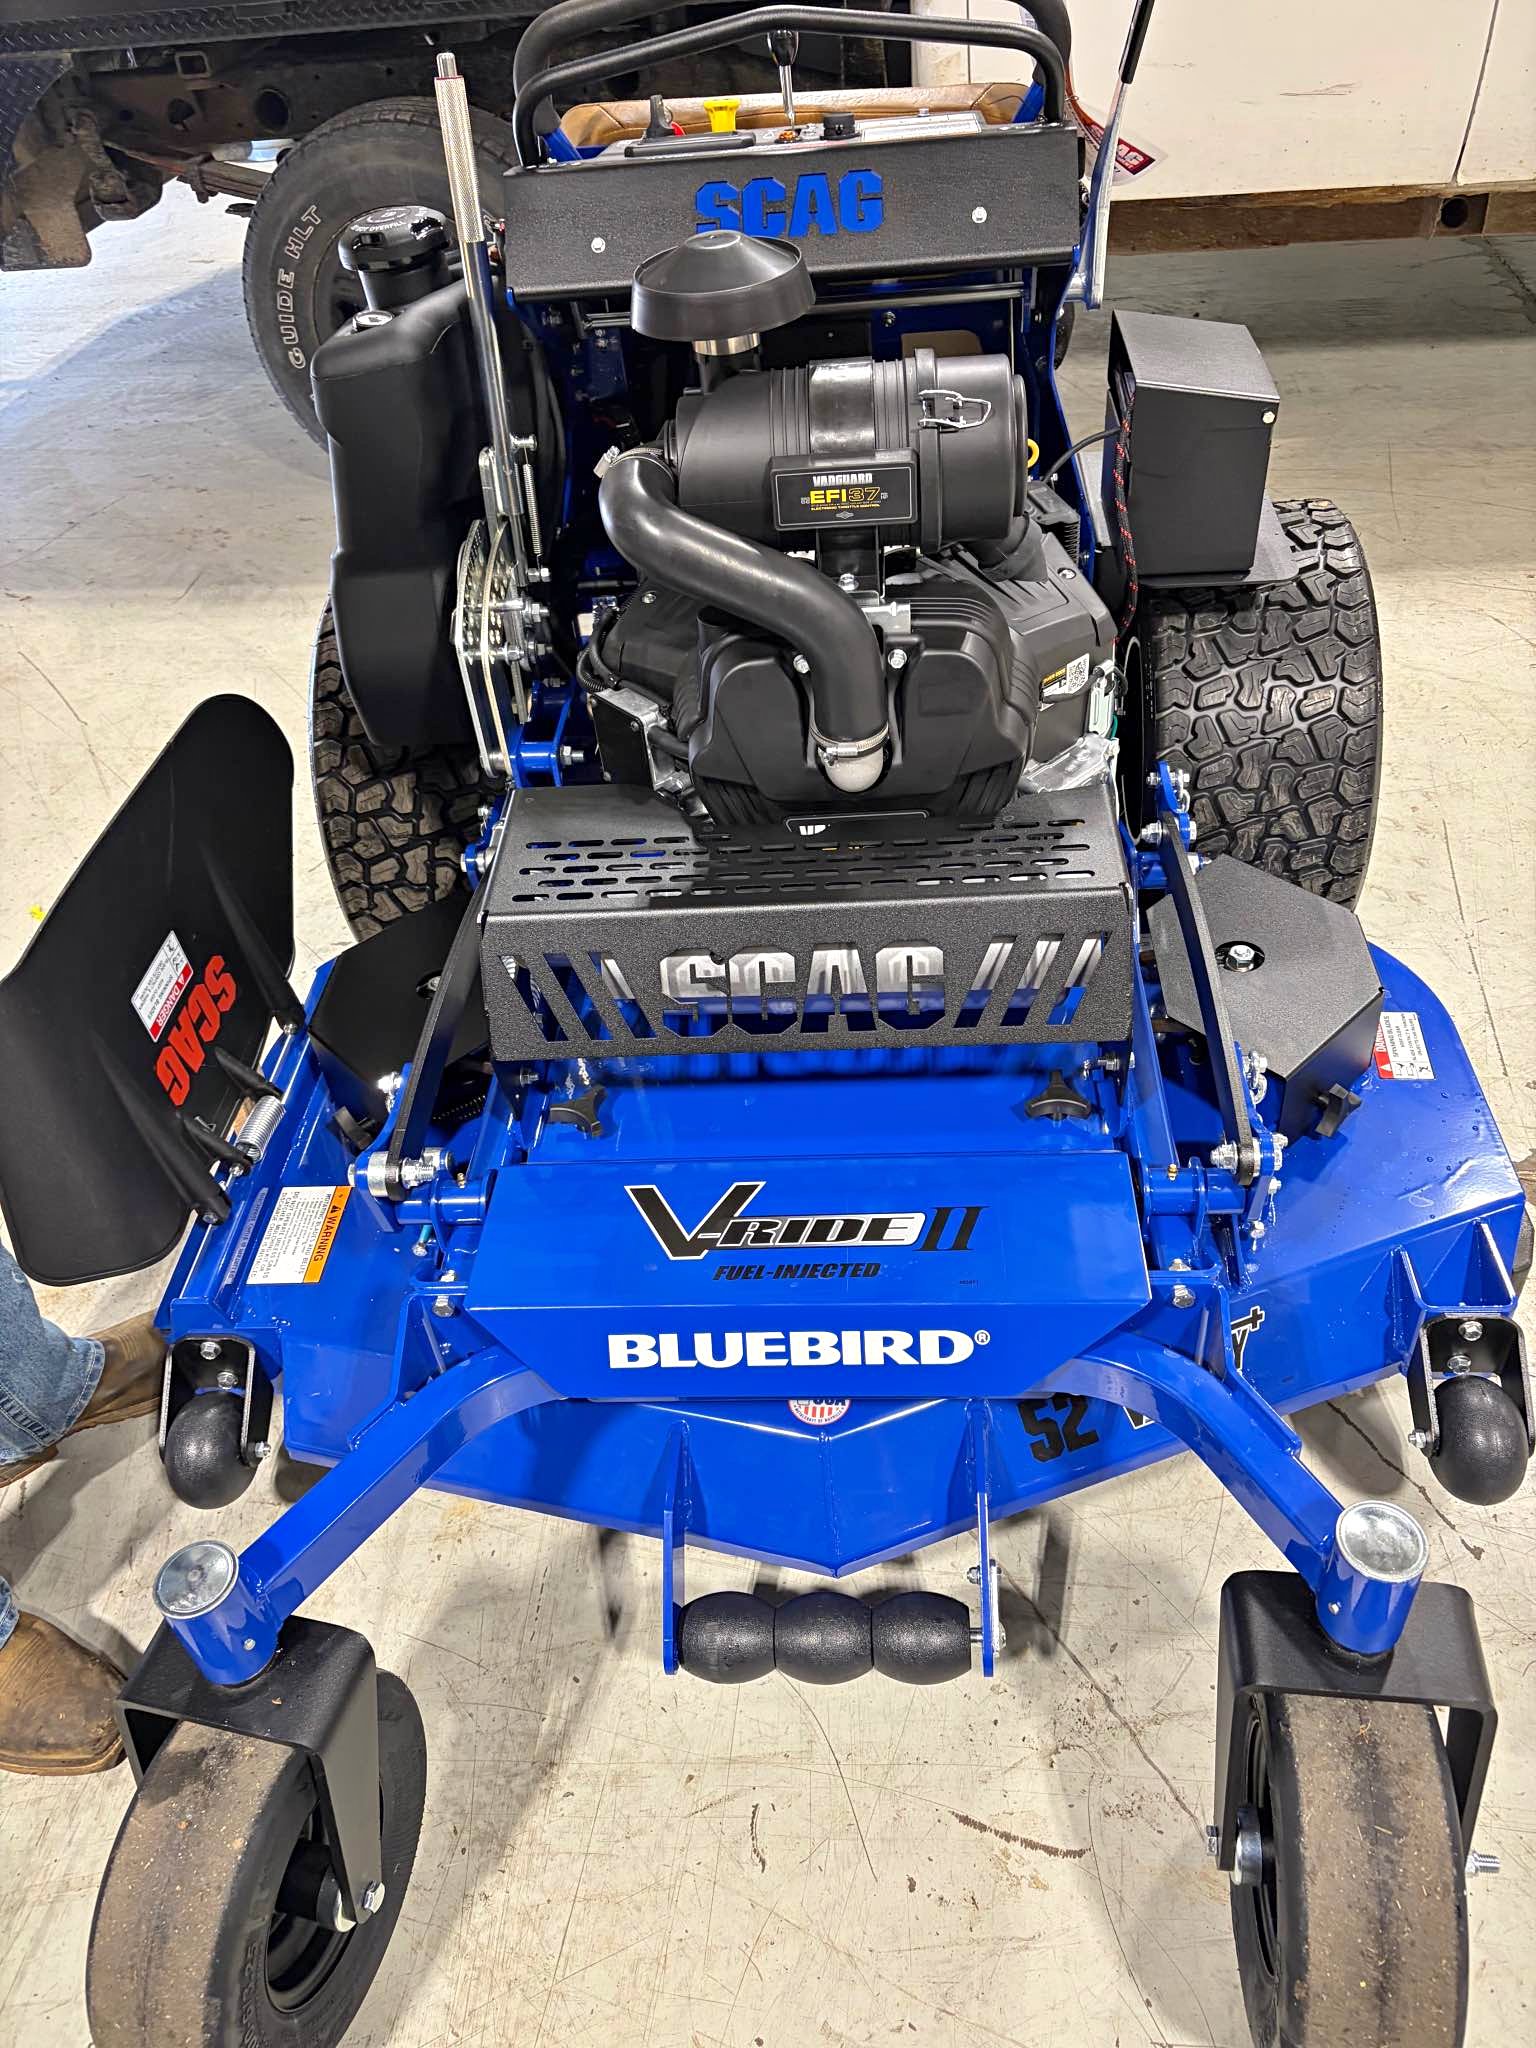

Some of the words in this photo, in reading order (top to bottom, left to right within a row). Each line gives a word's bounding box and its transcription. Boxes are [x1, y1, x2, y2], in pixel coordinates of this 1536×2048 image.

[284, 204, 321, 259] HLT
[694, 169, 884, 237] SCAG
[276, 268, 307, 369] GUIDE
[812, 472, 873, 487] VANGUARD
[156, 983, 180, 1027] DANGER
[659, 938, 945, 1039] SCAG
[155, 954, 237, 1106] SCAG
[313, 1215, 337, 1261] WARNING
[713, 1263, 881, 1280] FUEL-INJECTED
[1018, 1394, 1099, 1462] 52
